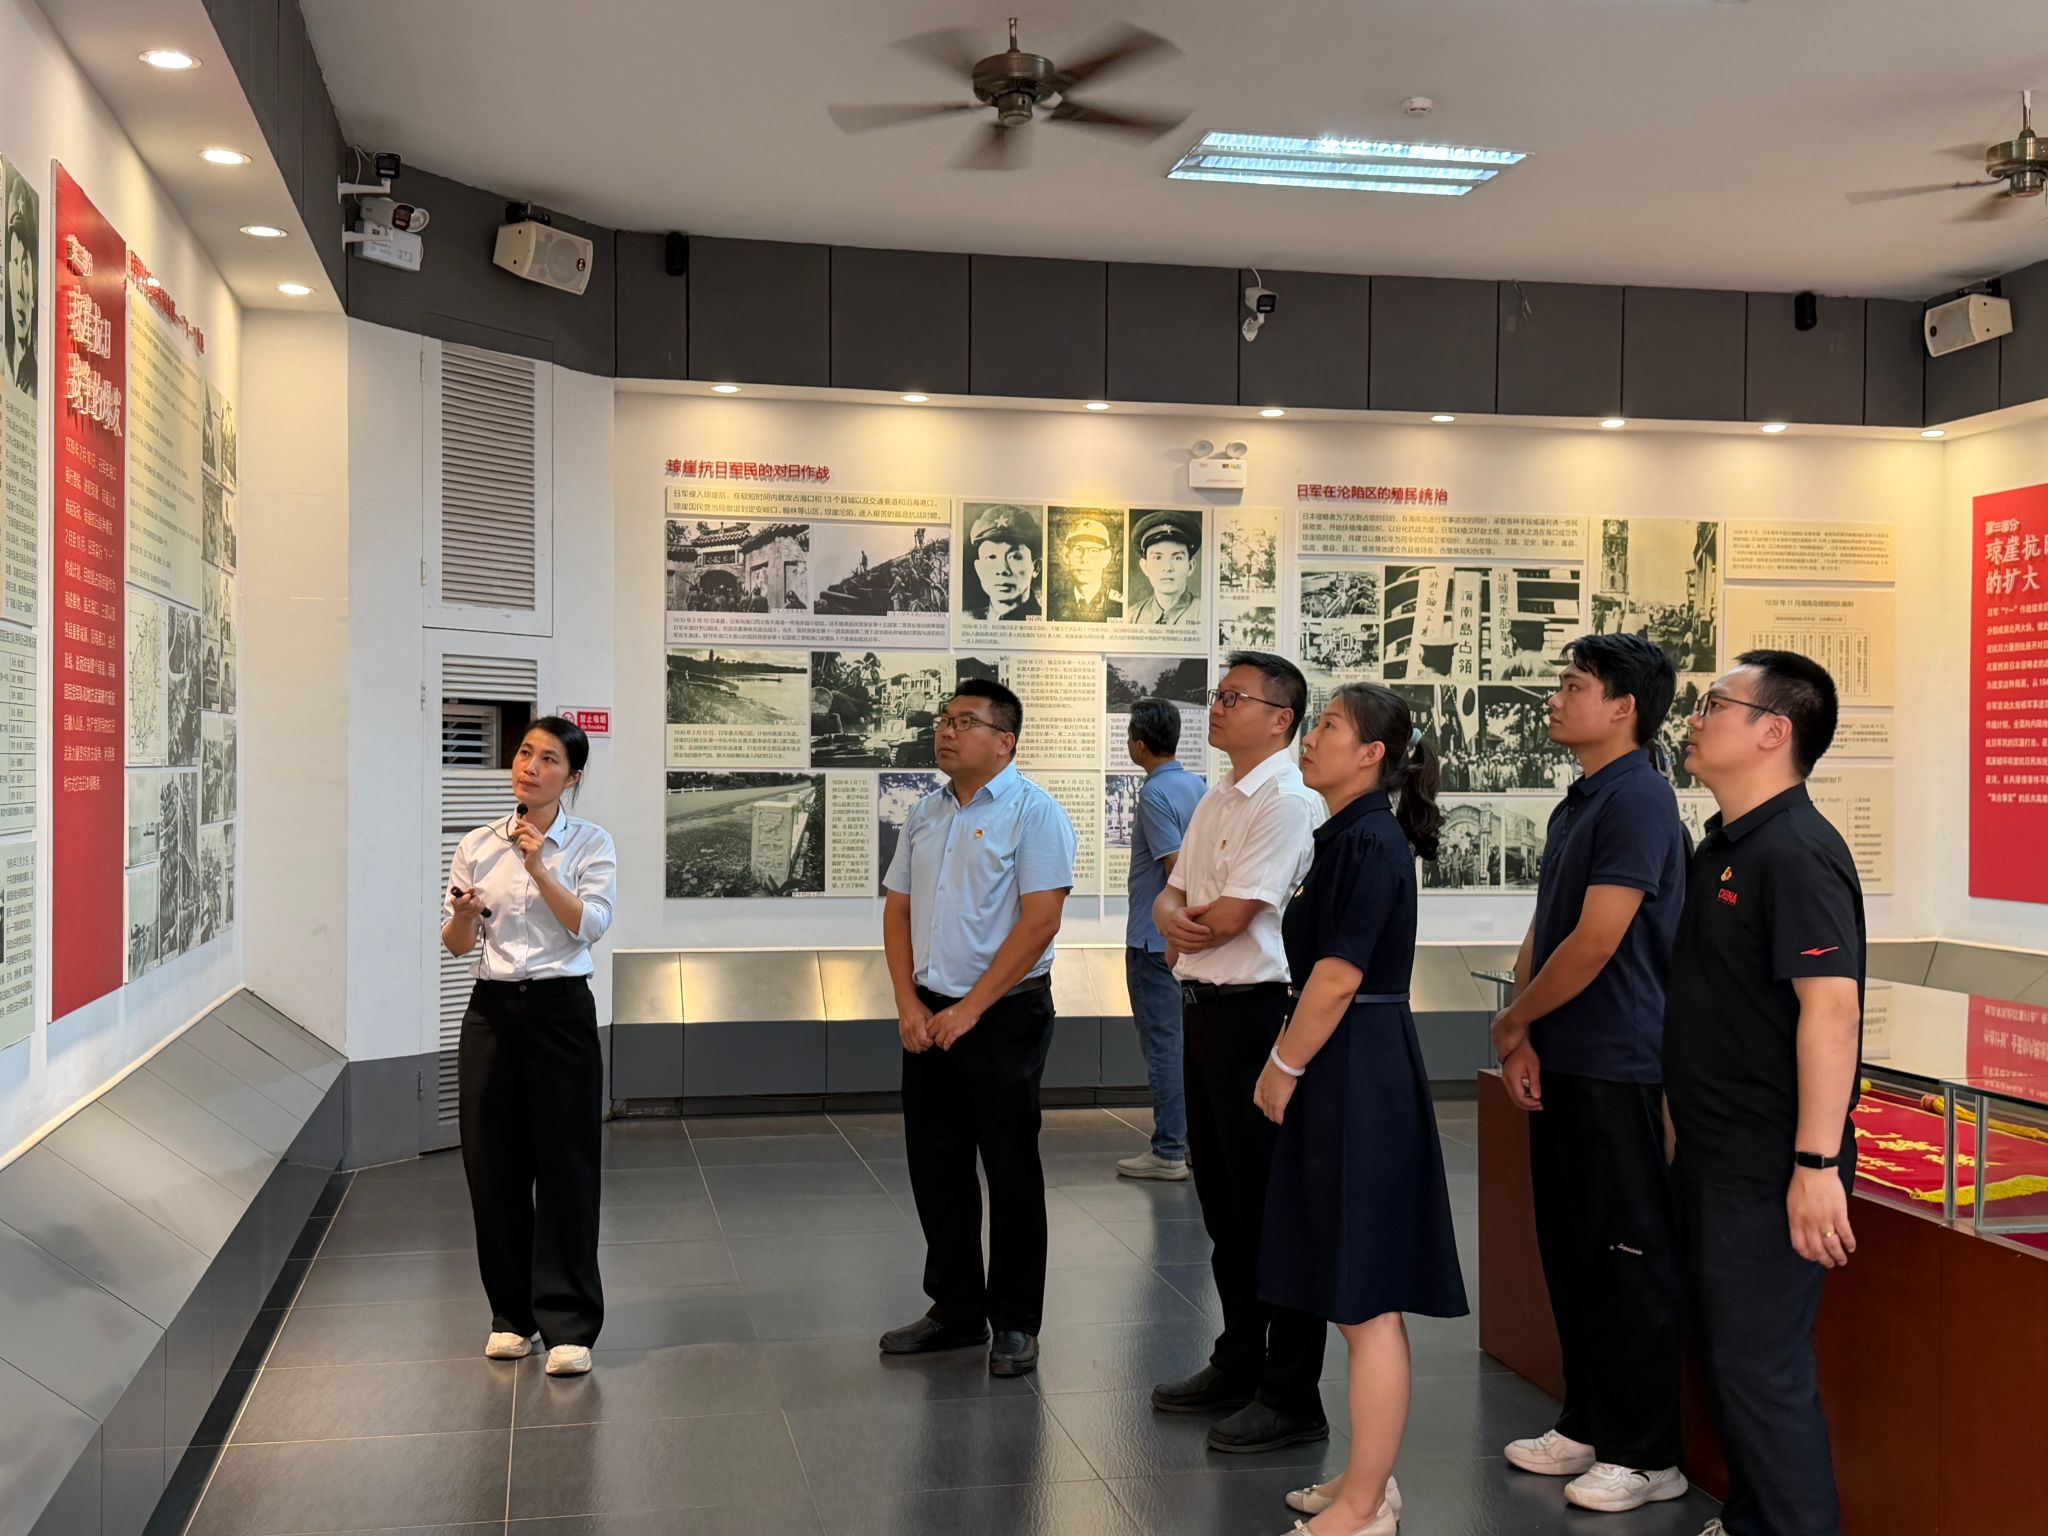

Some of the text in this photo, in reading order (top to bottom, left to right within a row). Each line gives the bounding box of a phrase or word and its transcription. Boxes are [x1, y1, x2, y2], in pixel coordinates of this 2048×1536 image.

[67, 285, 112, 359] 琼崖抗日
[65, 353, 123, 437] 战争的爆发
[666, 459, 830, 480] 琼崖抗日军民的对日作战
[1297, 484, 1448, 503] 日军在沦陷区的殖民统治
[1985, 518, 2019, 535] 第三部分
[1985, 533, 2048, 565] 琼崖抗
[1985, 565, 2040, 595] 的扩大
[1458, 590, 1474, 675] 海南島占領
